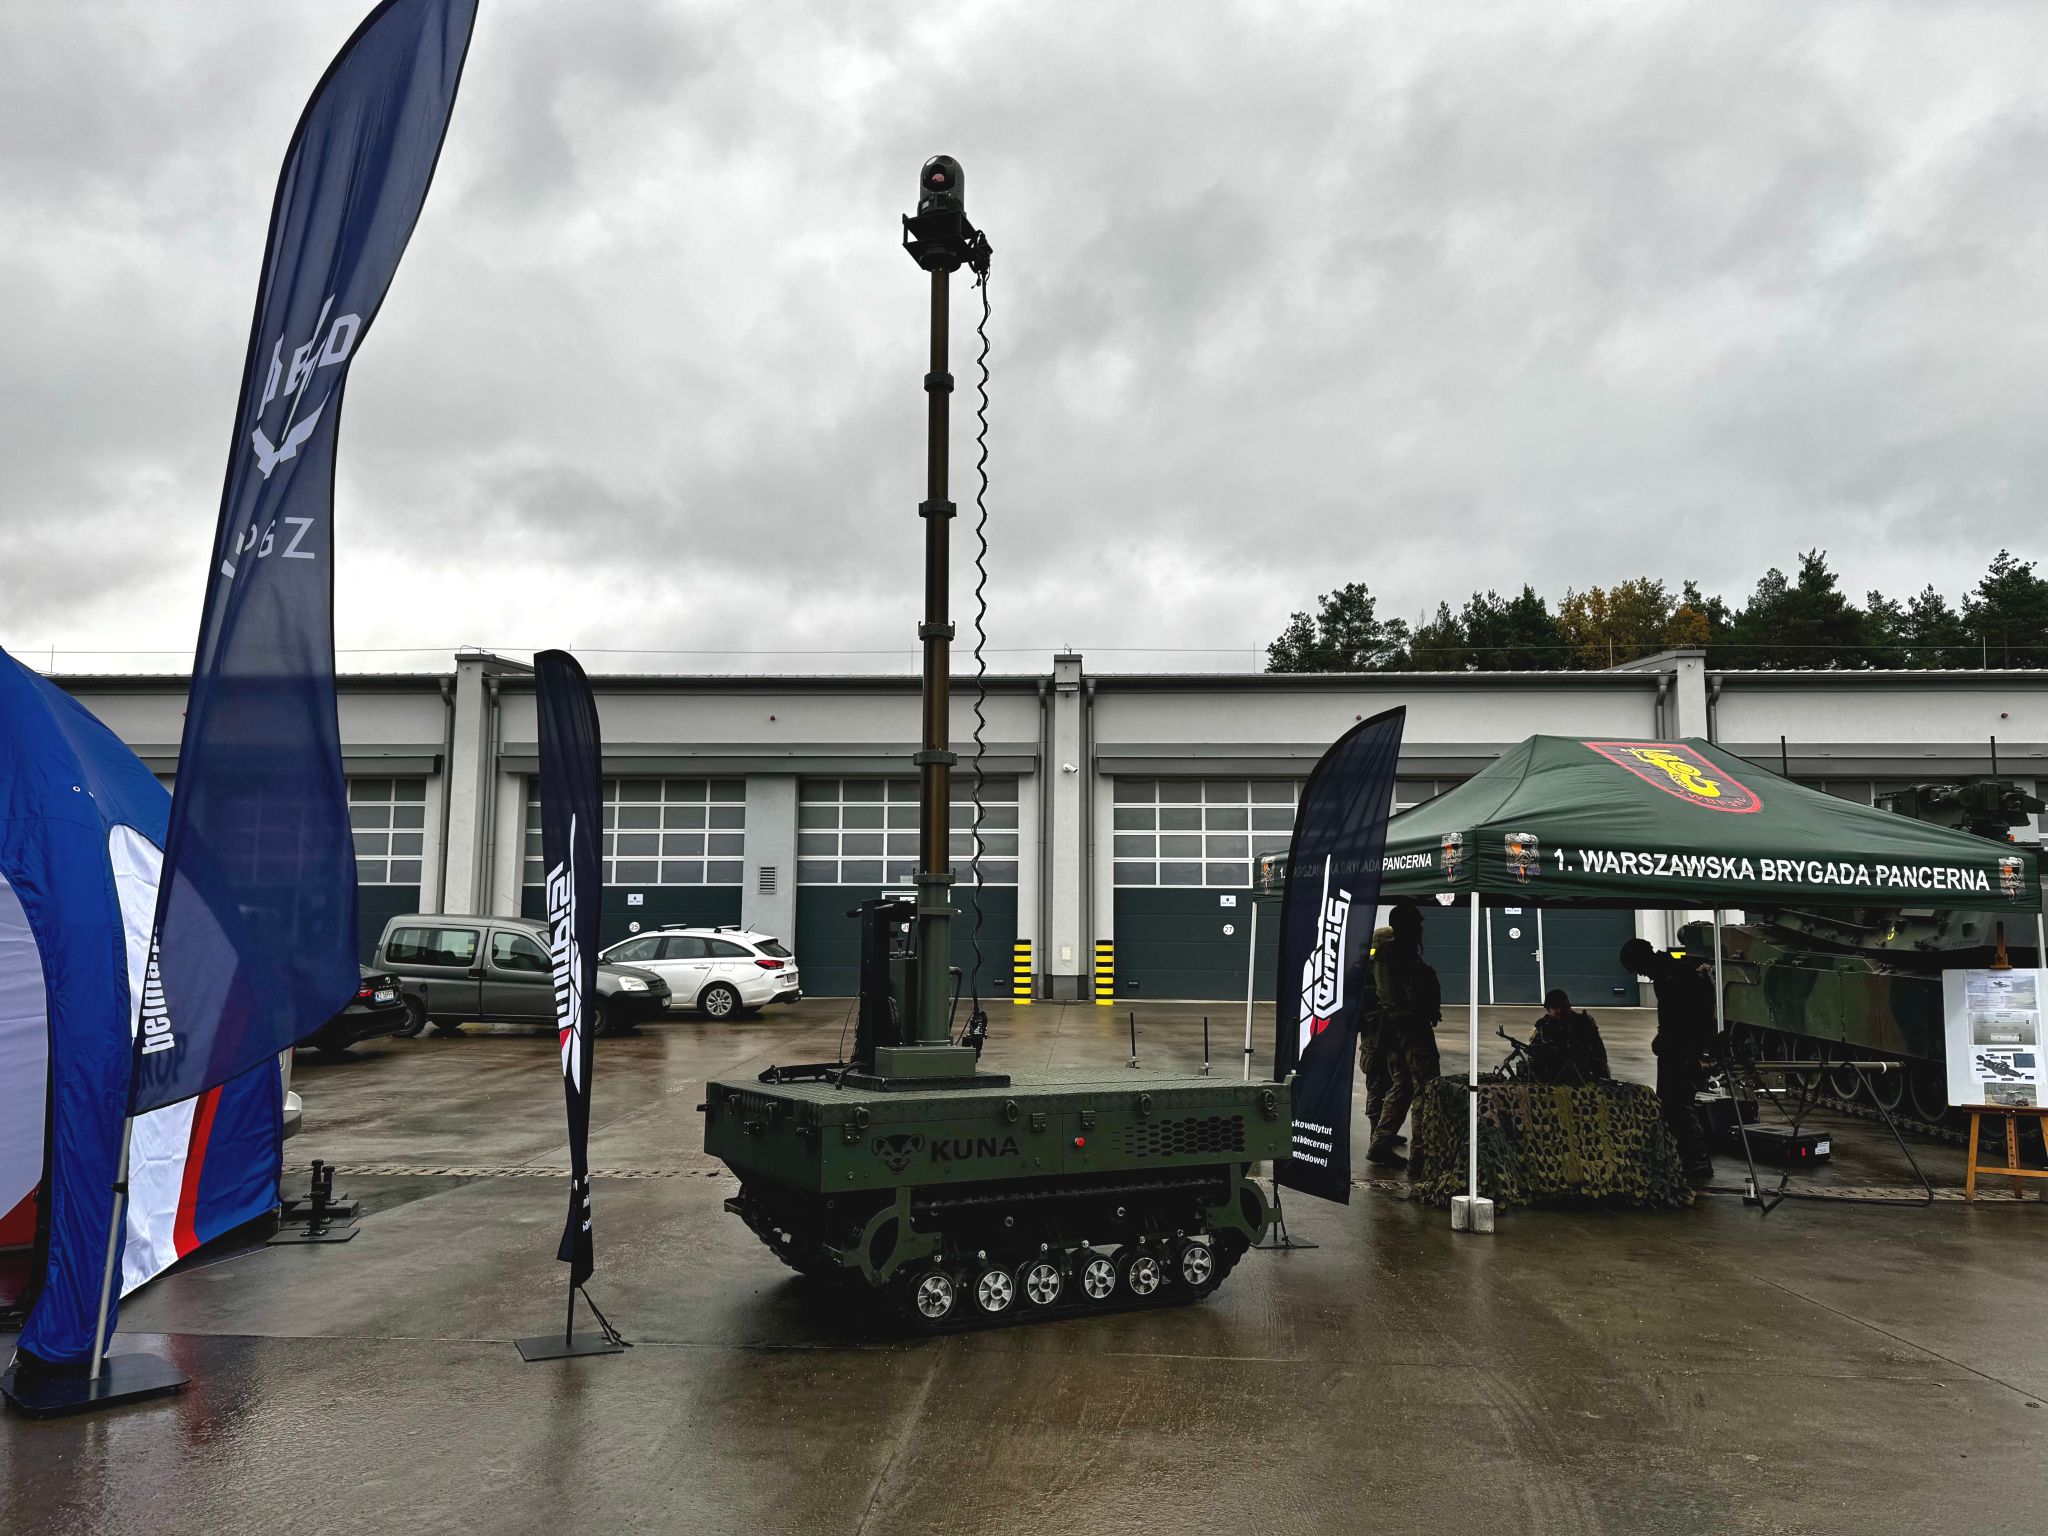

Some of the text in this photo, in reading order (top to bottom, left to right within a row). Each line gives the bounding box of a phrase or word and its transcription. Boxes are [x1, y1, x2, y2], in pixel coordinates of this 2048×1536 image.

[1382, 853, 1432, 871] PANCERNA
[1554, 848, 1990, 891] 1. WARSZAWSKA BRYGADA PANCERNA
[931, 1136, 1019, 1162] KUNA
